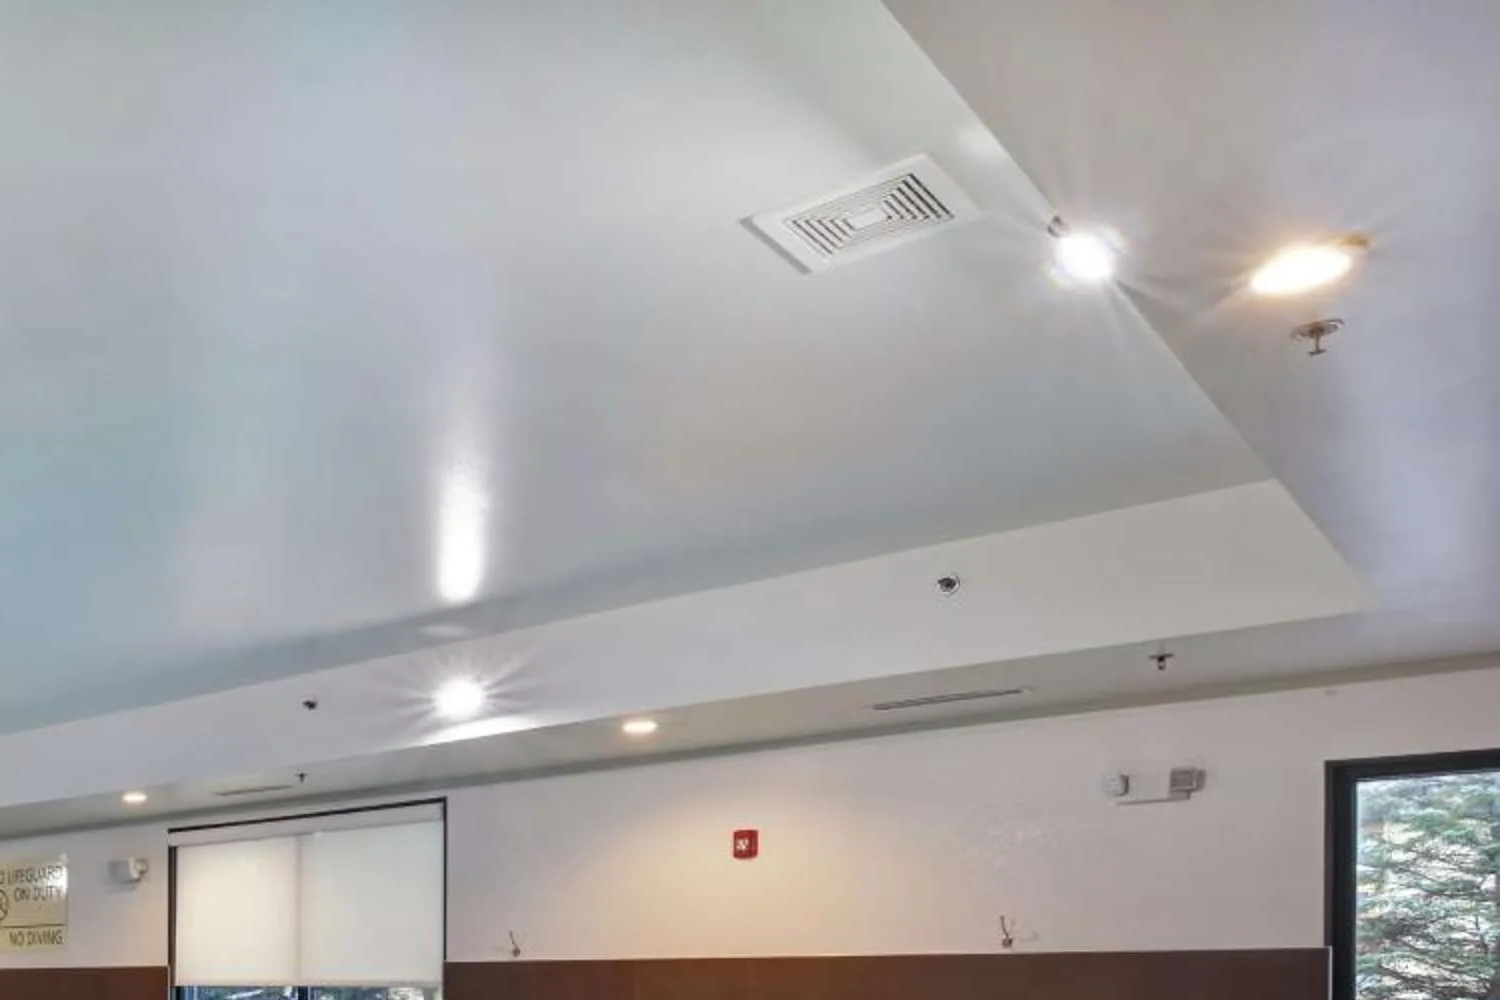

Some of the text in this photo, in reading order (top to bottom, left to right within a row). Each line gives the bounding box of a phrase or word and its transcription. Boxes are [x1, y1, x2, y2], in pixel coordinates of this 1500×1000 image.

[14, 884, 65, 902] ON DUTY
[8, 928, 65, 947] NO DIVING
